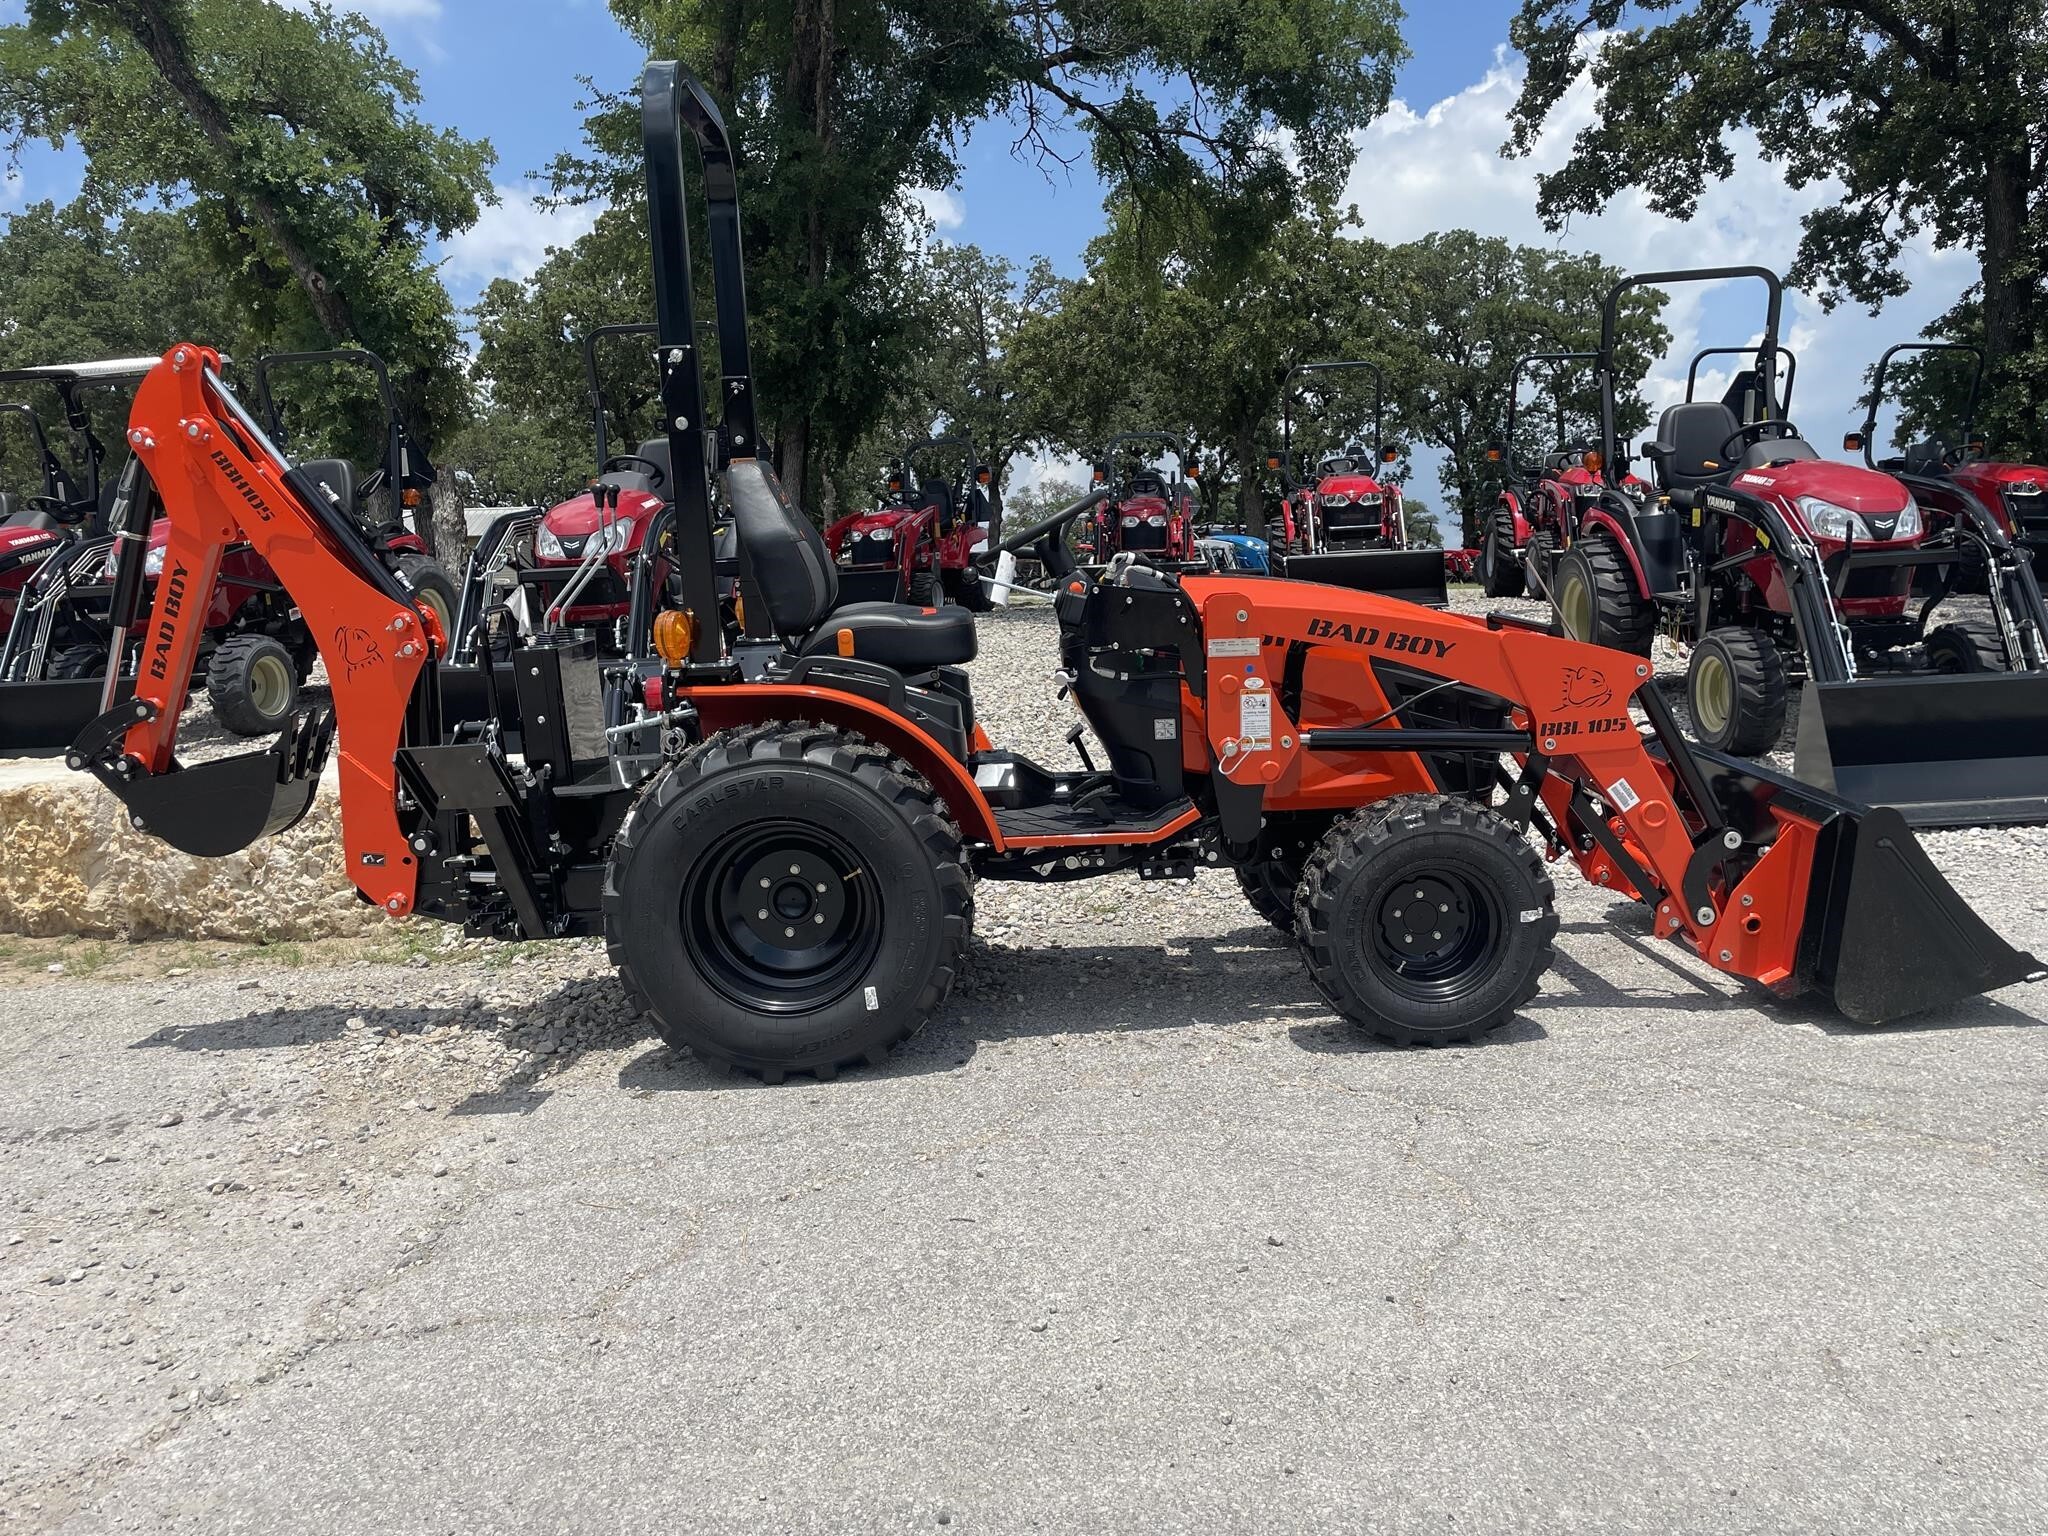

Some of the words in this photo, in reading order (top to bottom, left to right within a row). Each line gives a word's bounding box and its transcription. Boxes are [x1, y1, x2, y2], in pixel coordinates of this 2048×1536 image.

[1706, 494, 1736, 512] YANMAR
[8, 534, 41, 546] YANMAR
[150, 621, 175, 680] BAD
[164, 559, 188, 618] BOY
[1307, 618, 1379, 646] BAD
[1384, 632, 1457, 658] BOY
[1540, 721, 1583, 736] BBL
[1588, 717, 1627, 733] 105
[672, 776, 785, 832] CARLSTAR
